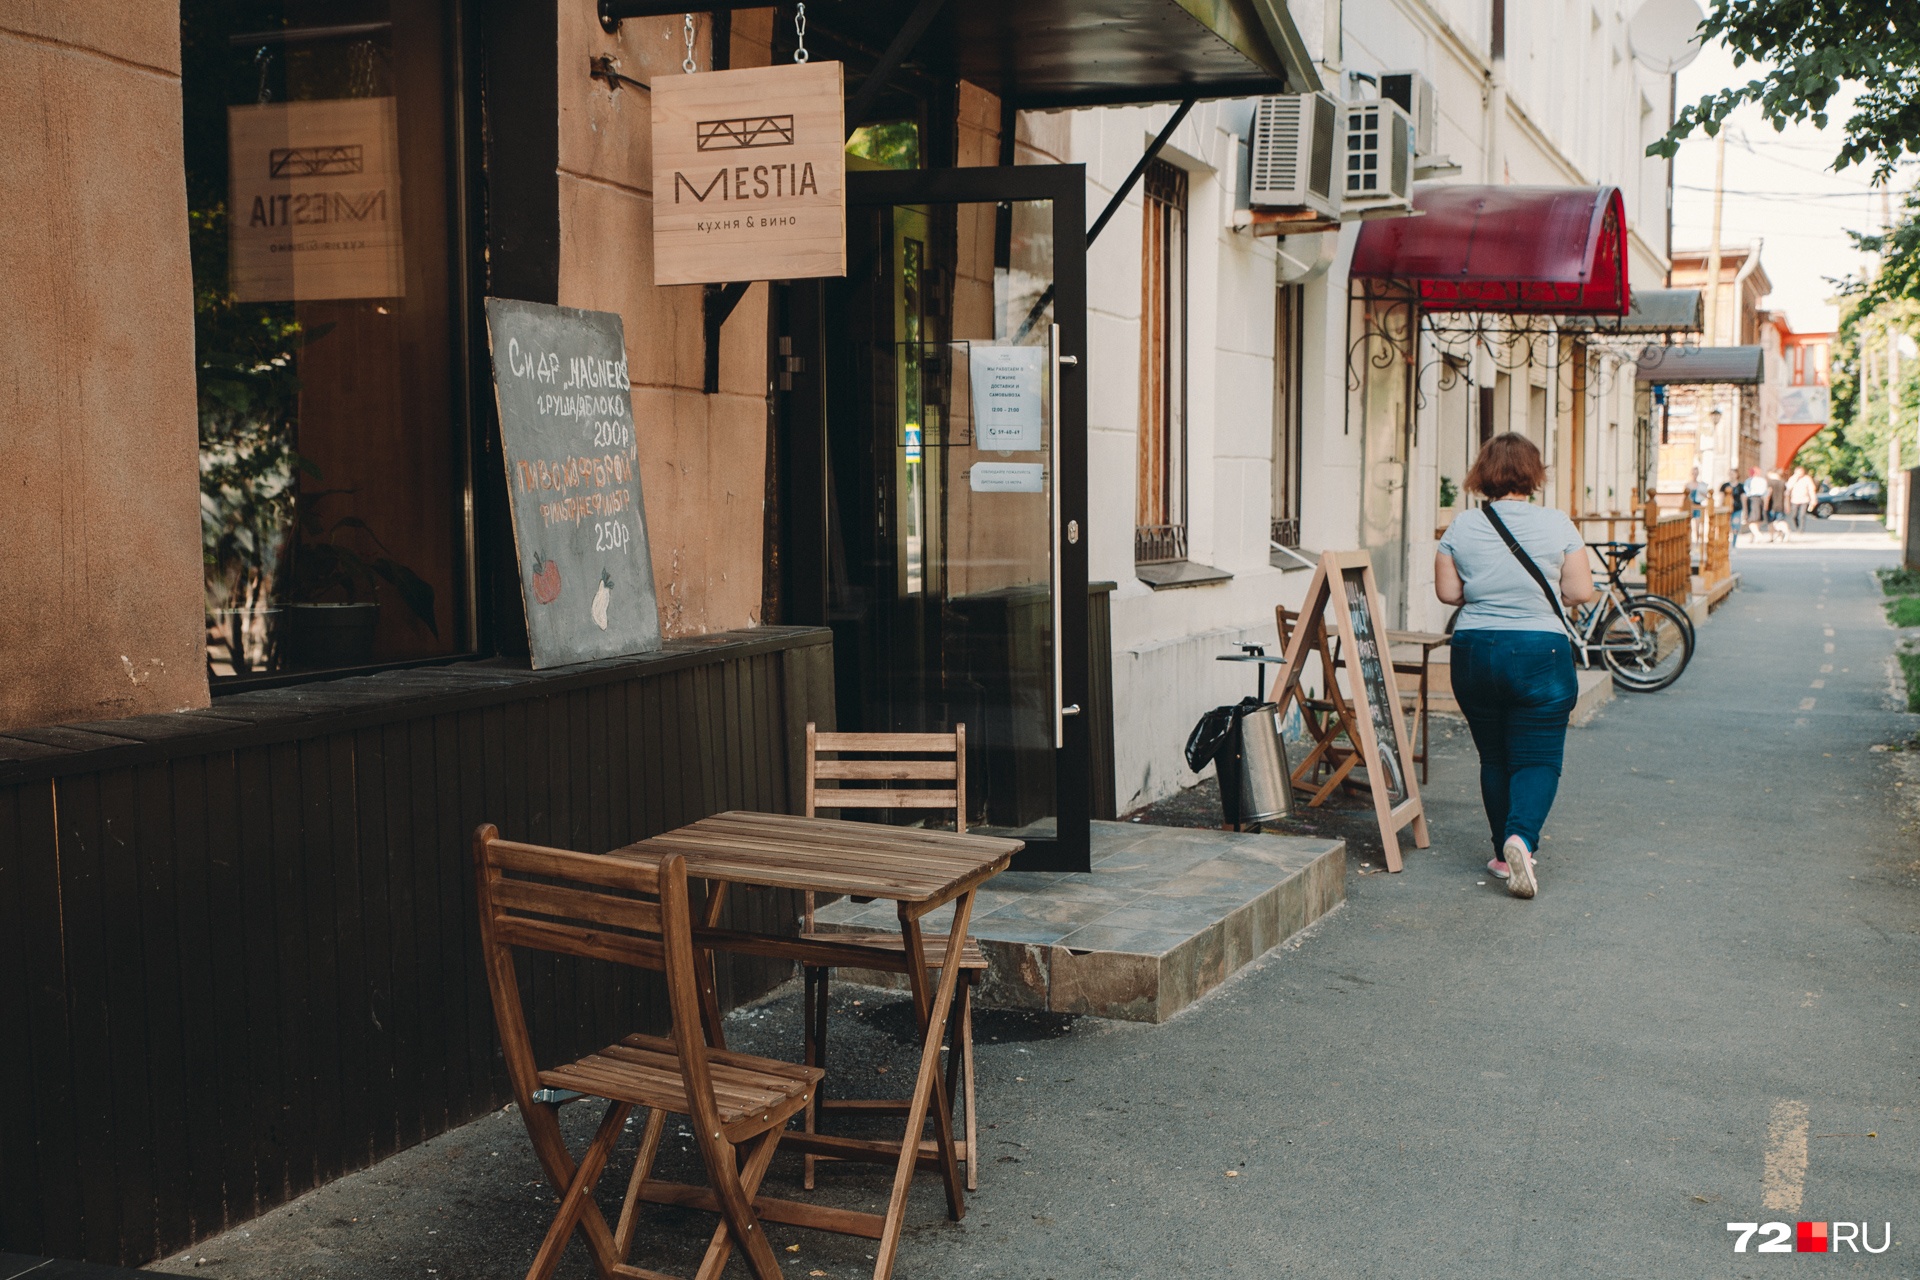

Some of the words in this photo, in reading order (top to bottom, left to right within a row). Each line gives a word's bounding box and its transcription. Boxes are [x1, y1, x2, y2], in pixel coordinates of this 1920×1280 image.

[674, 162, 818, 204] MESTIA
[697, 218, 740, 233] кухня
[746, 216, 755, 228] &
[760, 216, 797, 227] вино
